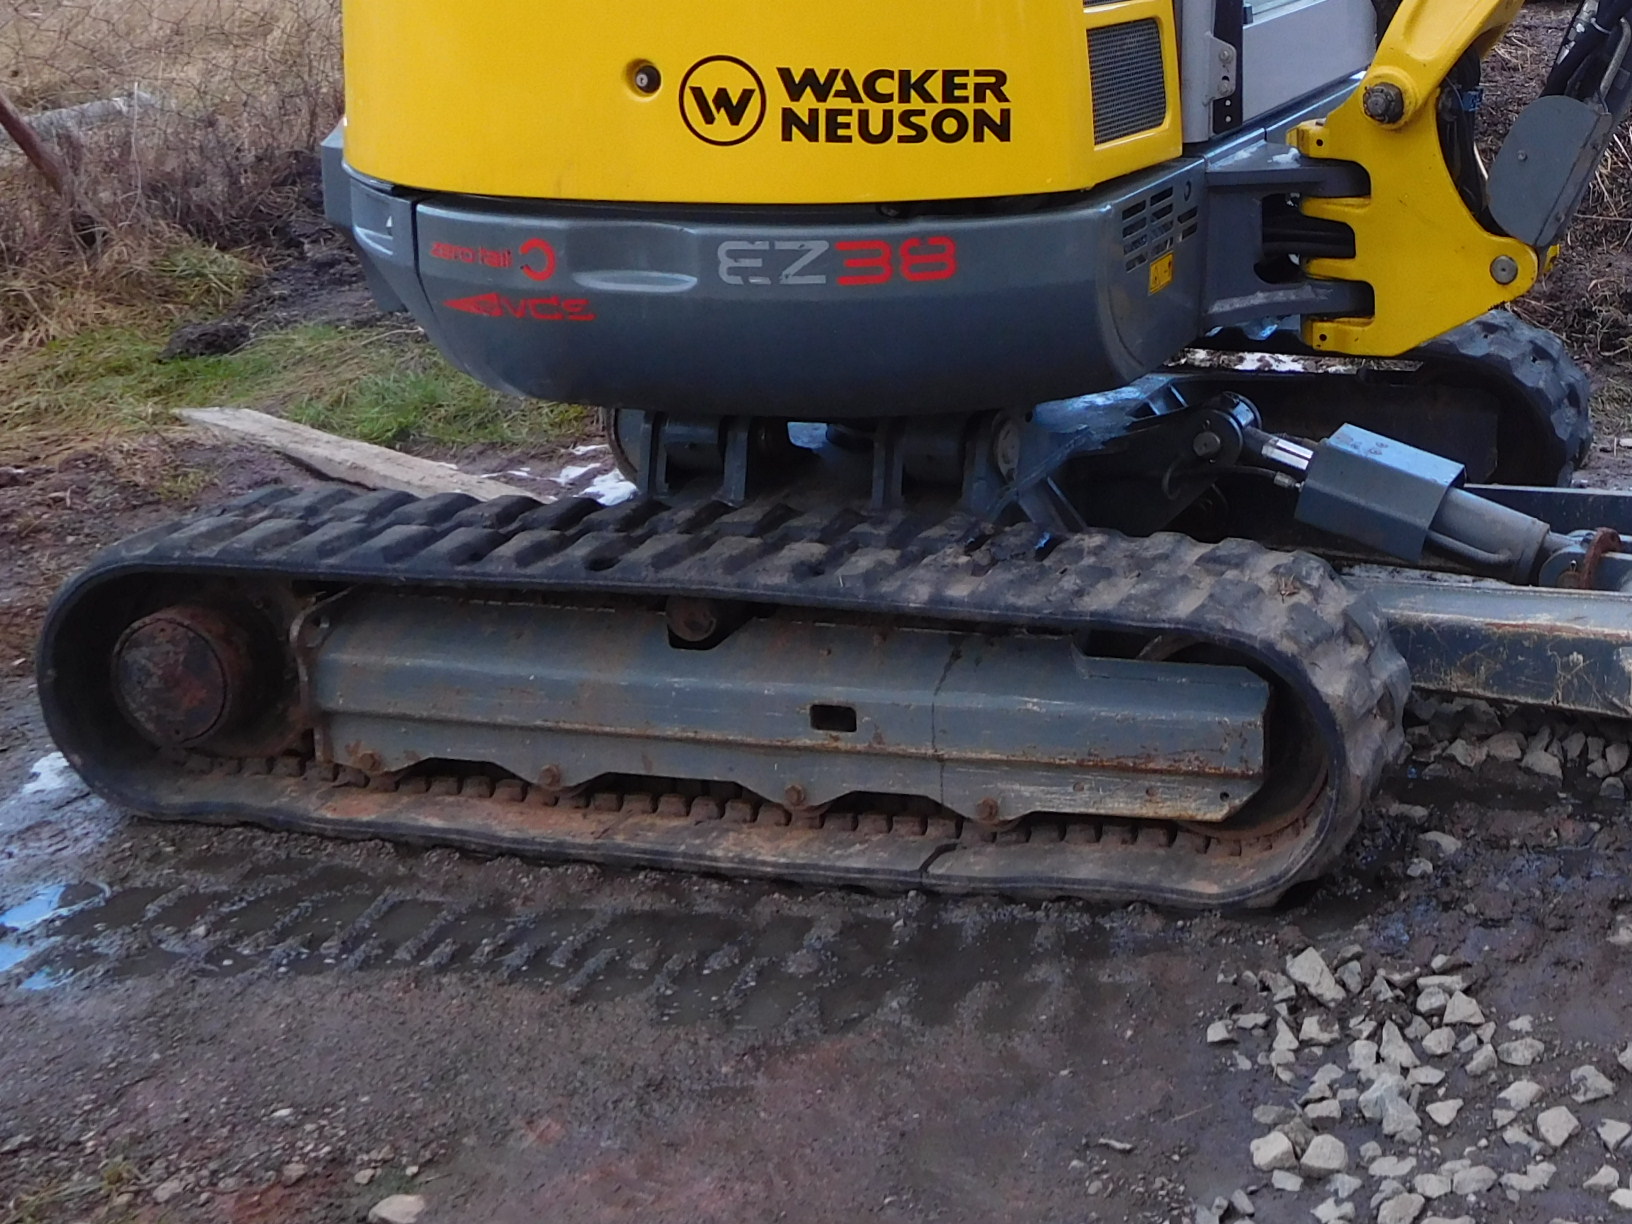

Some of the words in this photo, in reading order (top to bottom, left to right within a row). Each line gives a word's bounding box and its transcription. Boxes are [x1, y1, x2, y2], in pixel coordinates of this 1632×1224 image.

[776, 67, 1011, 104] WACKER
[780, 107, 1012, 144] NEUSON
[717, 235, 958, 286] EZ38
